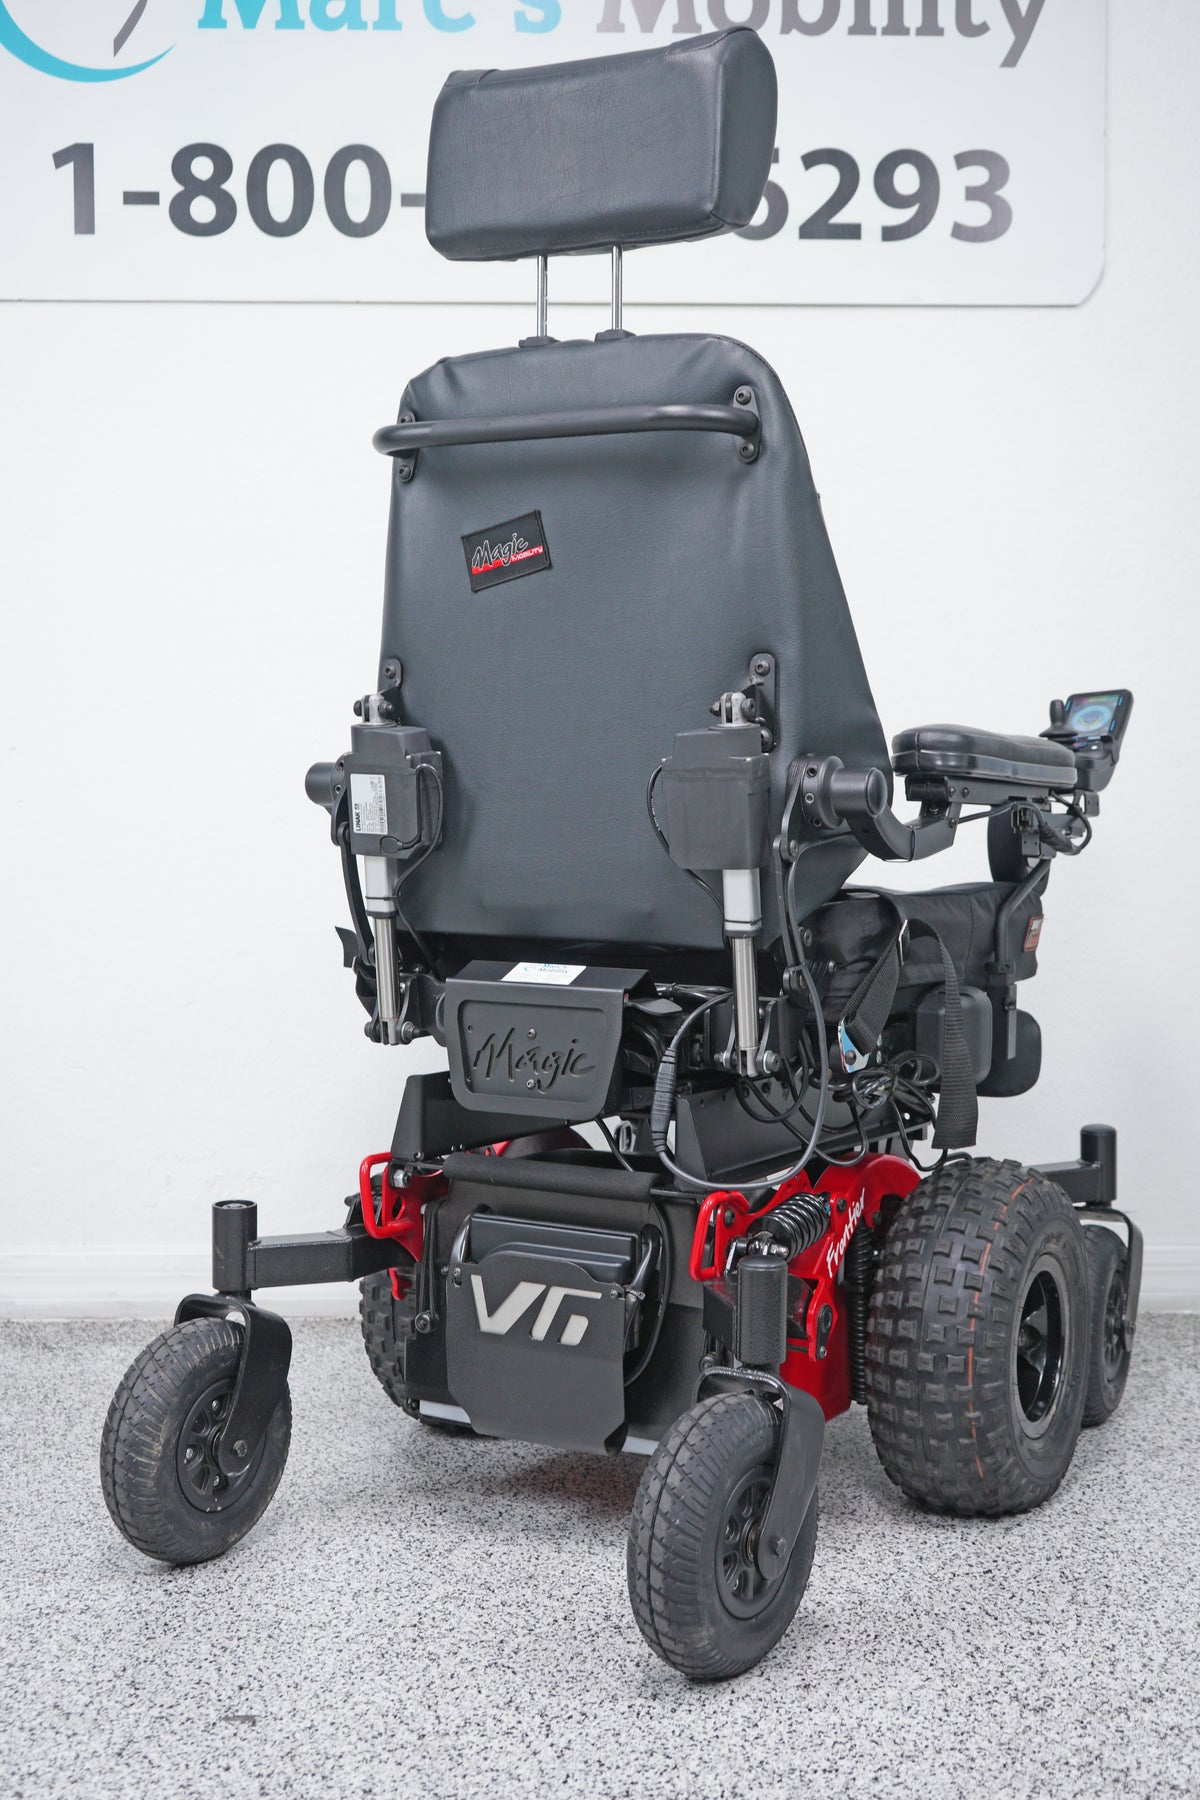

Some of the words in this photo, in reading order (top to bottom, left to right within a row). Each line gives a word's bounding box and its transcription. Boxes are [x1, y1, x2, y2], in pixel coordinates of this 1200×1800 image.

[471, 532, 529, 571] Magic
[472, 1027, 595, 1094] Magic
[826, 1187, 865, 1279] Frontier
